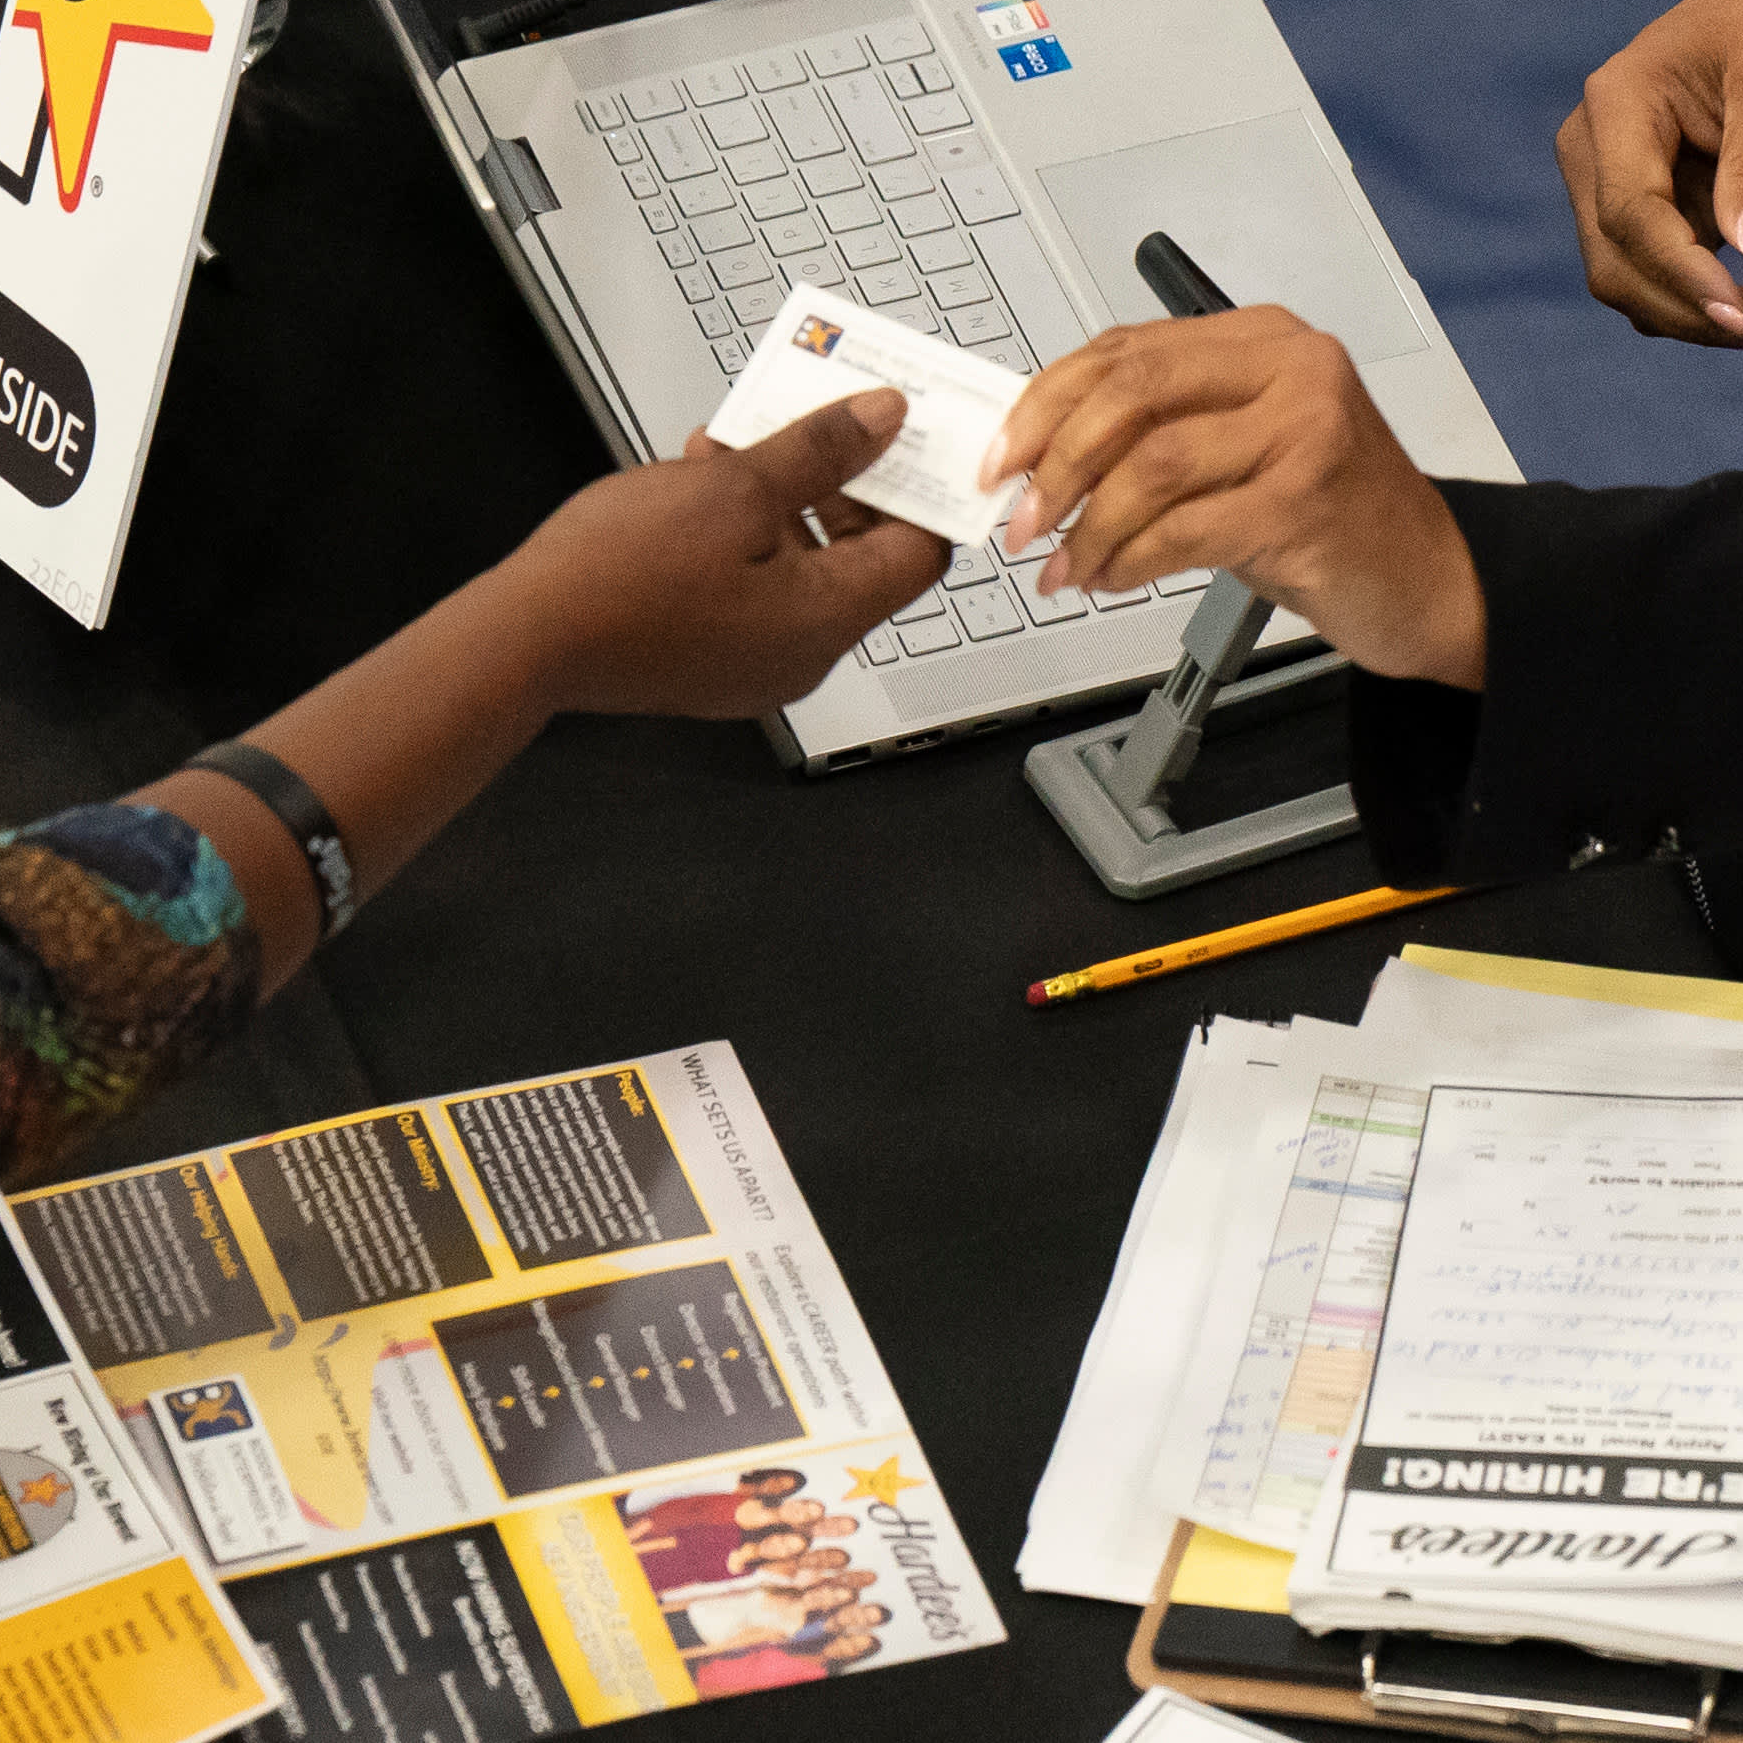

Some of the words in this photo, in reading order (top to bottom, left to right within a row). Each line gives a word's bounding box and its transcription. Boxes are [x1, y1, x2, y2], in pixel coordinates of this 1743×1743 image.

[681, 1053, 715, 1097] WHAT
[703, 1102, 735, 1140] SETS
[723, 1144, 746, 1163] US
[733, 1167, 773, 1219] APART?
[1386, 1459, 1602, 1494] HIRING!
[1393, 1523, 1734, 1569] Hardee's
[868, 1502, 970, 1642] Hardee's
